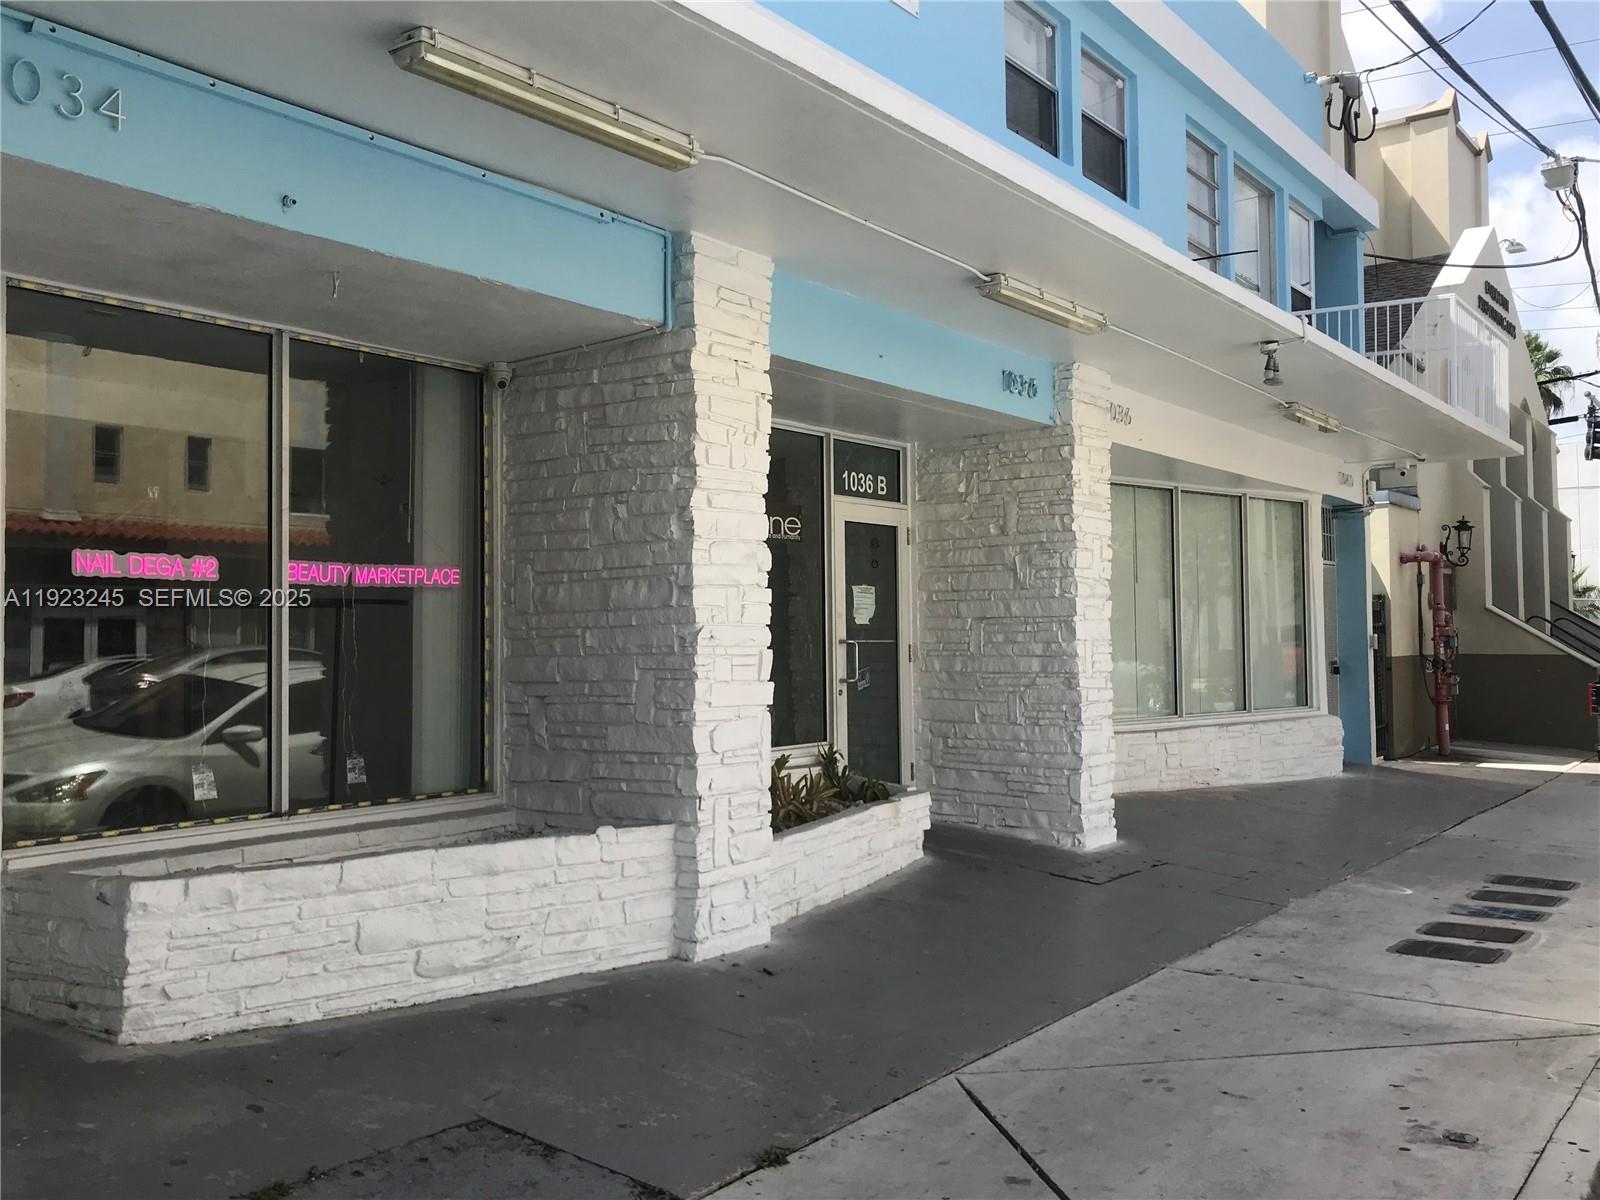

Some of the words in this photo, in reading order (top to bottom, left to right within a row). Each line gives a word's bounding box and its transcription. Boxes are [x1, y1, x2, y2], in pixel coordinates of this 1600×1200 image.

[842, 470, 874, 493] 1036
[877, 475, 887, 495] B
[76, 552, 121, 574] NAIL
[128, 555, 185, 577] DEGA
[191, 558, 217, 578] #2
[288, 563, 350, 583] BEAUTY
[355, 567, 460, 585] MARKETPLACE
